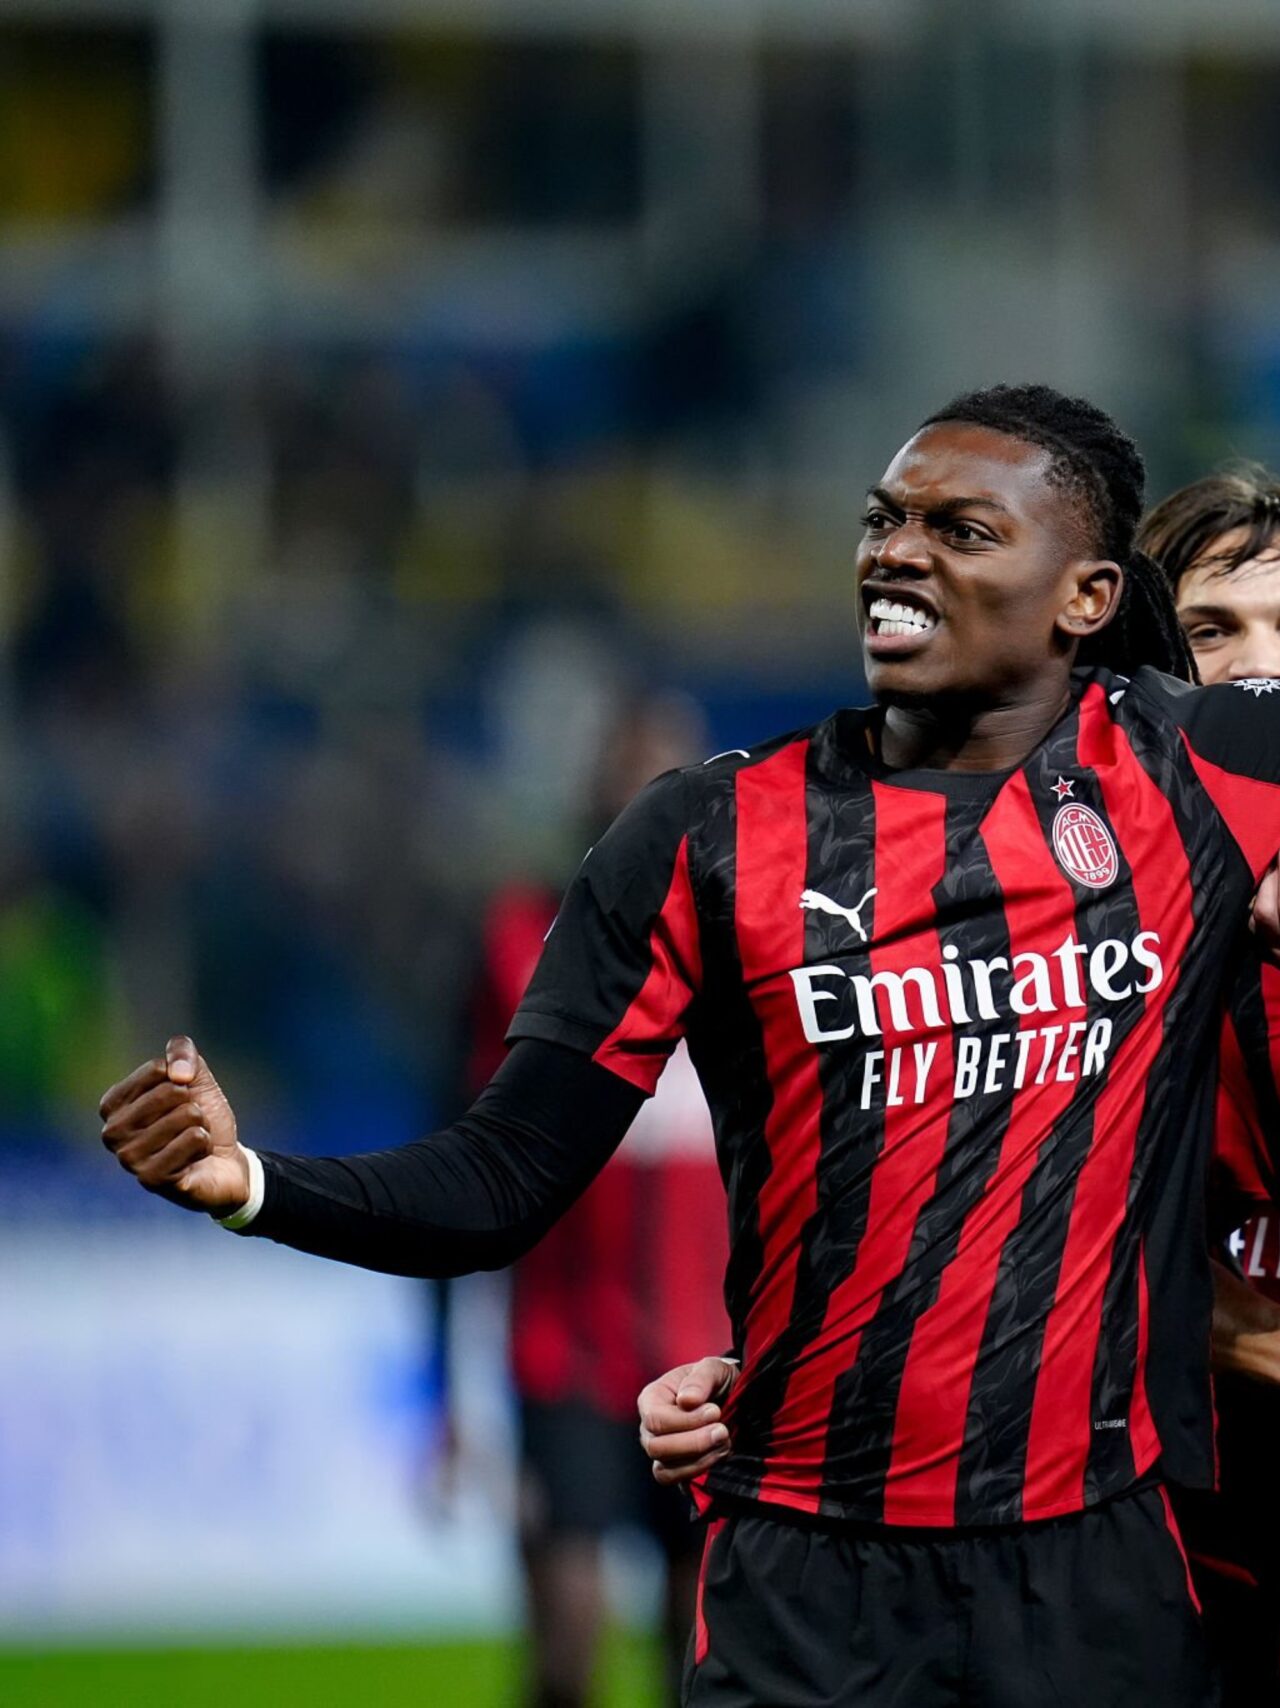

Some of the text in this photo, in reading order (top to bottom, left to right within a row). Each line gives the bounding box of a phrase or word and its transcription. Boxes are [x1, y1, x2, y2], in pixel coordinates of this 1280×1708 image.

[1060, 810, 1091, 833] ACM
[1083, 866, 1110, 881] 1899
[789, 931, 1163, 1044] Emirates
[860, 1017, 1112, 1110] FLY BETTER
